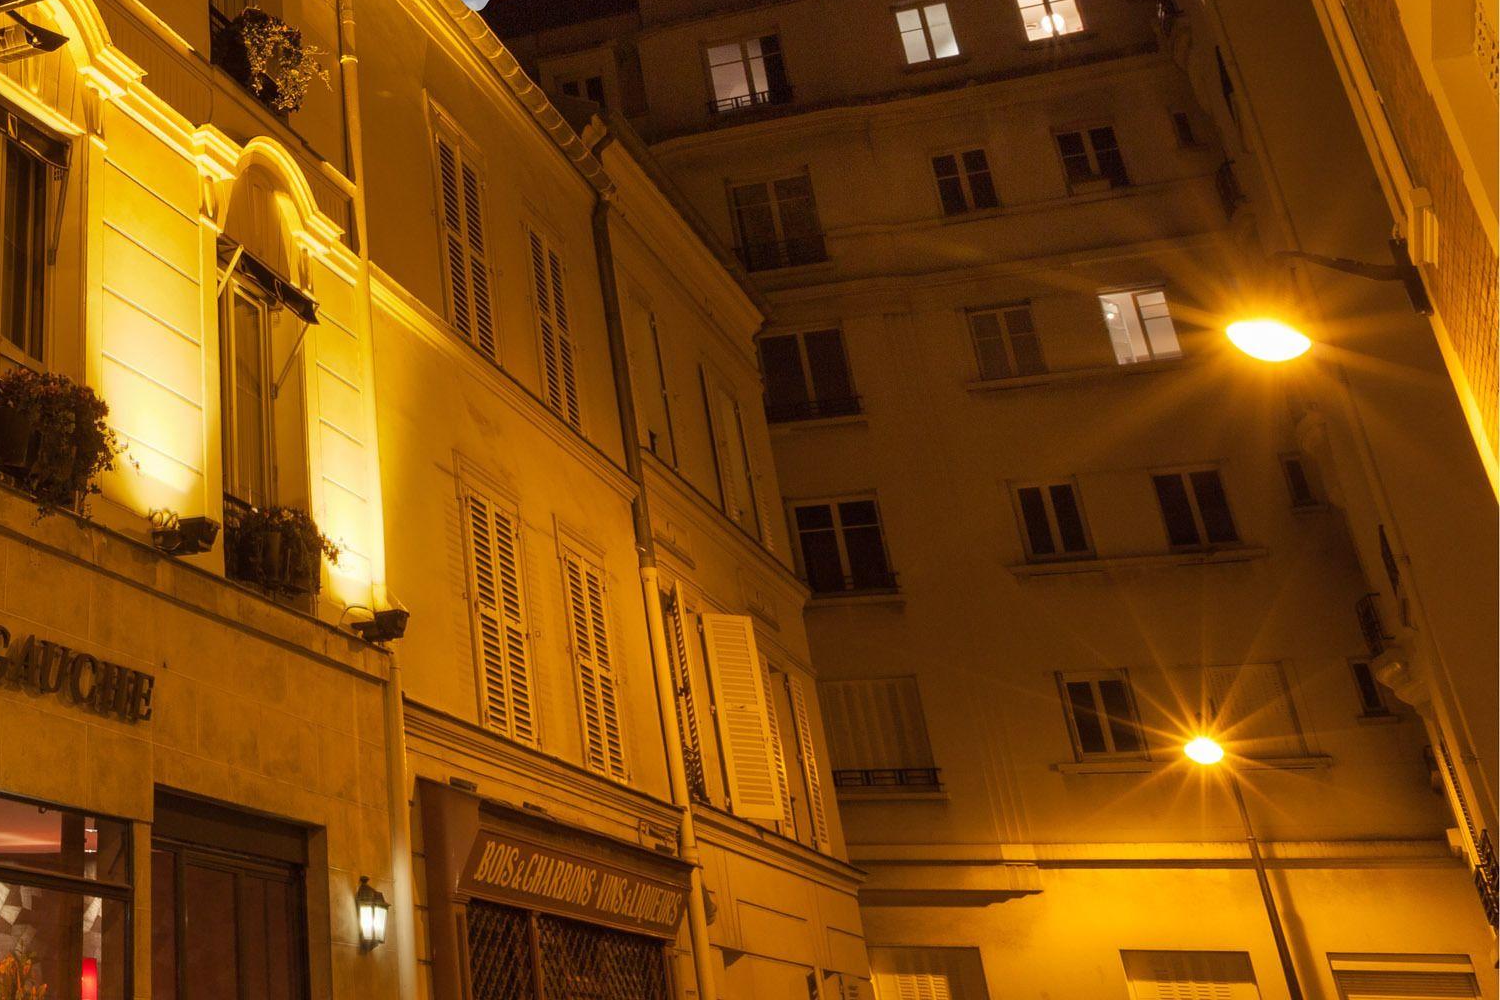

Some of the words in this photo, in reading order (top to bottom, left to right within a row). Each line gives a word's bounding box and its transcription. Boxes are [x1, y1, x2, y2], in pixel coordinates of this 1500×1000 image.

[474, 840, 520, 888] BOIS
[595, 873, 628, 915] VINS
[629, 882, 683, 927] LIQUEURS
